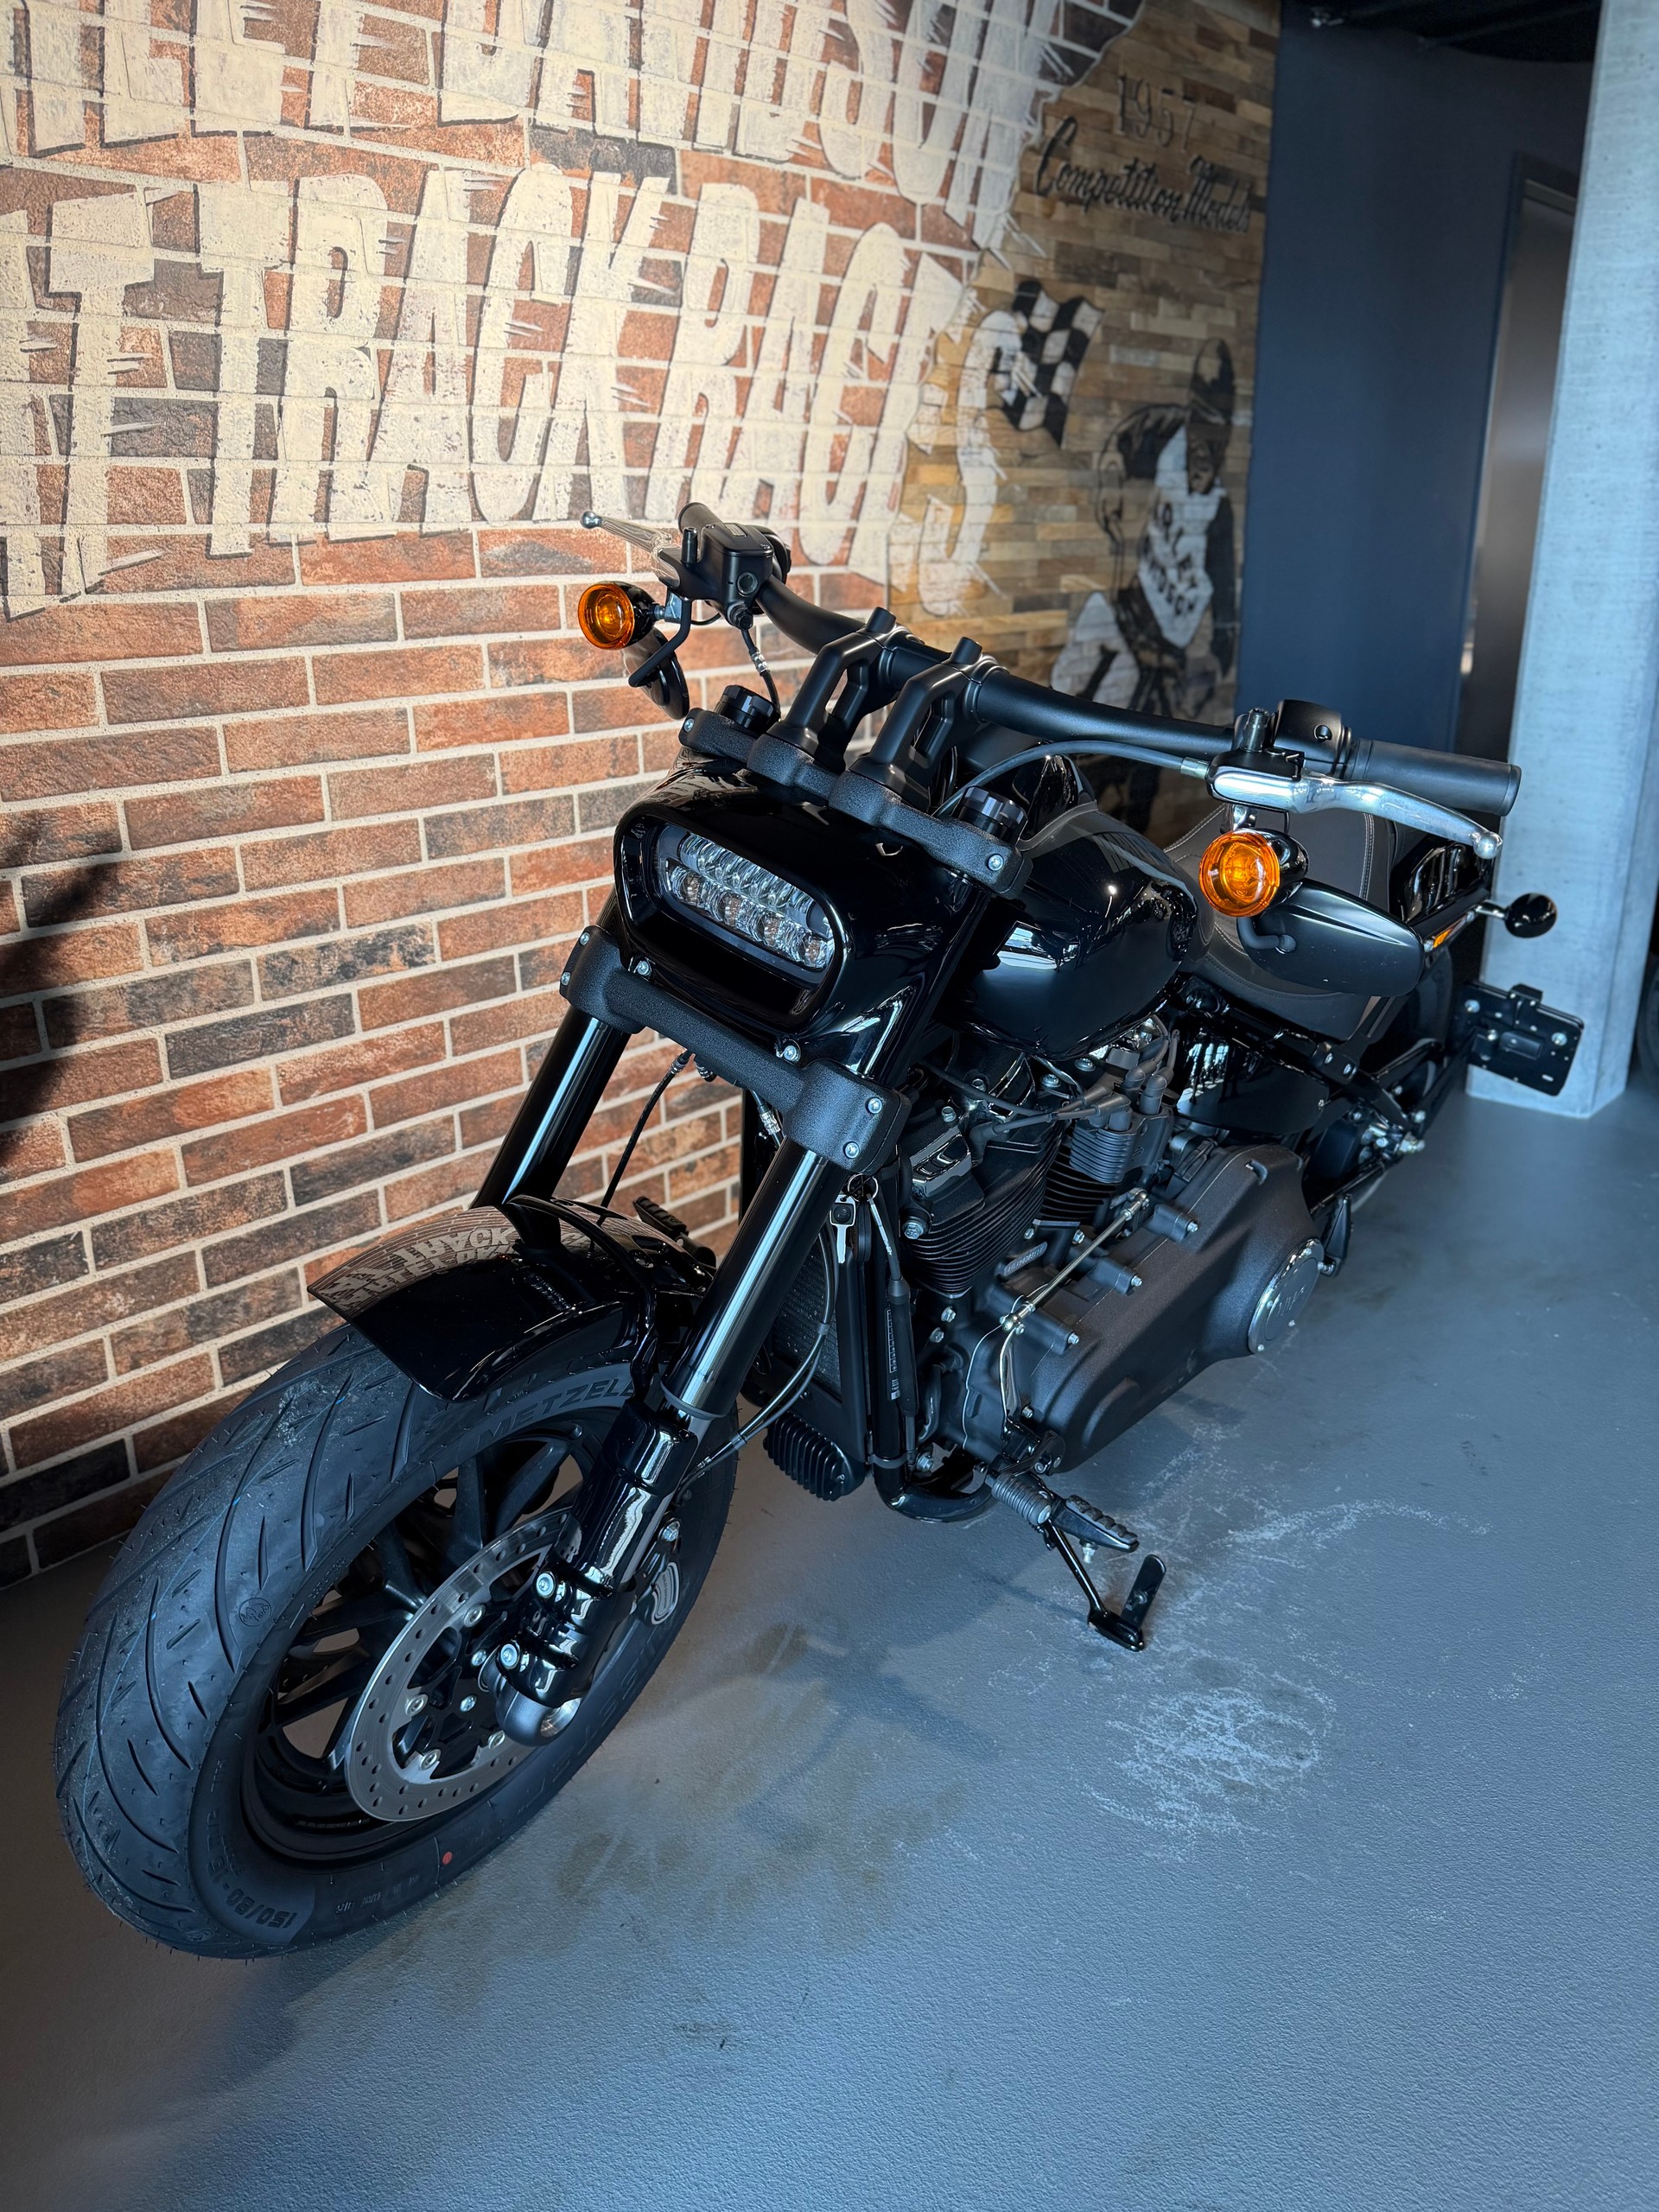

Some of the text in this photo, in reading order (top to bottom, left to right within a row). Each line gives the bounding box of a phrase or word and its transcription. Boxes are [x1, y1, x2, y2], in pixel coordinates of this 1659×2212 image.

[1033, 115, 1182, 224] Competition
[195, 164, 670, 558] TRACK
[476, 1378, 635, 1452] METZEL
